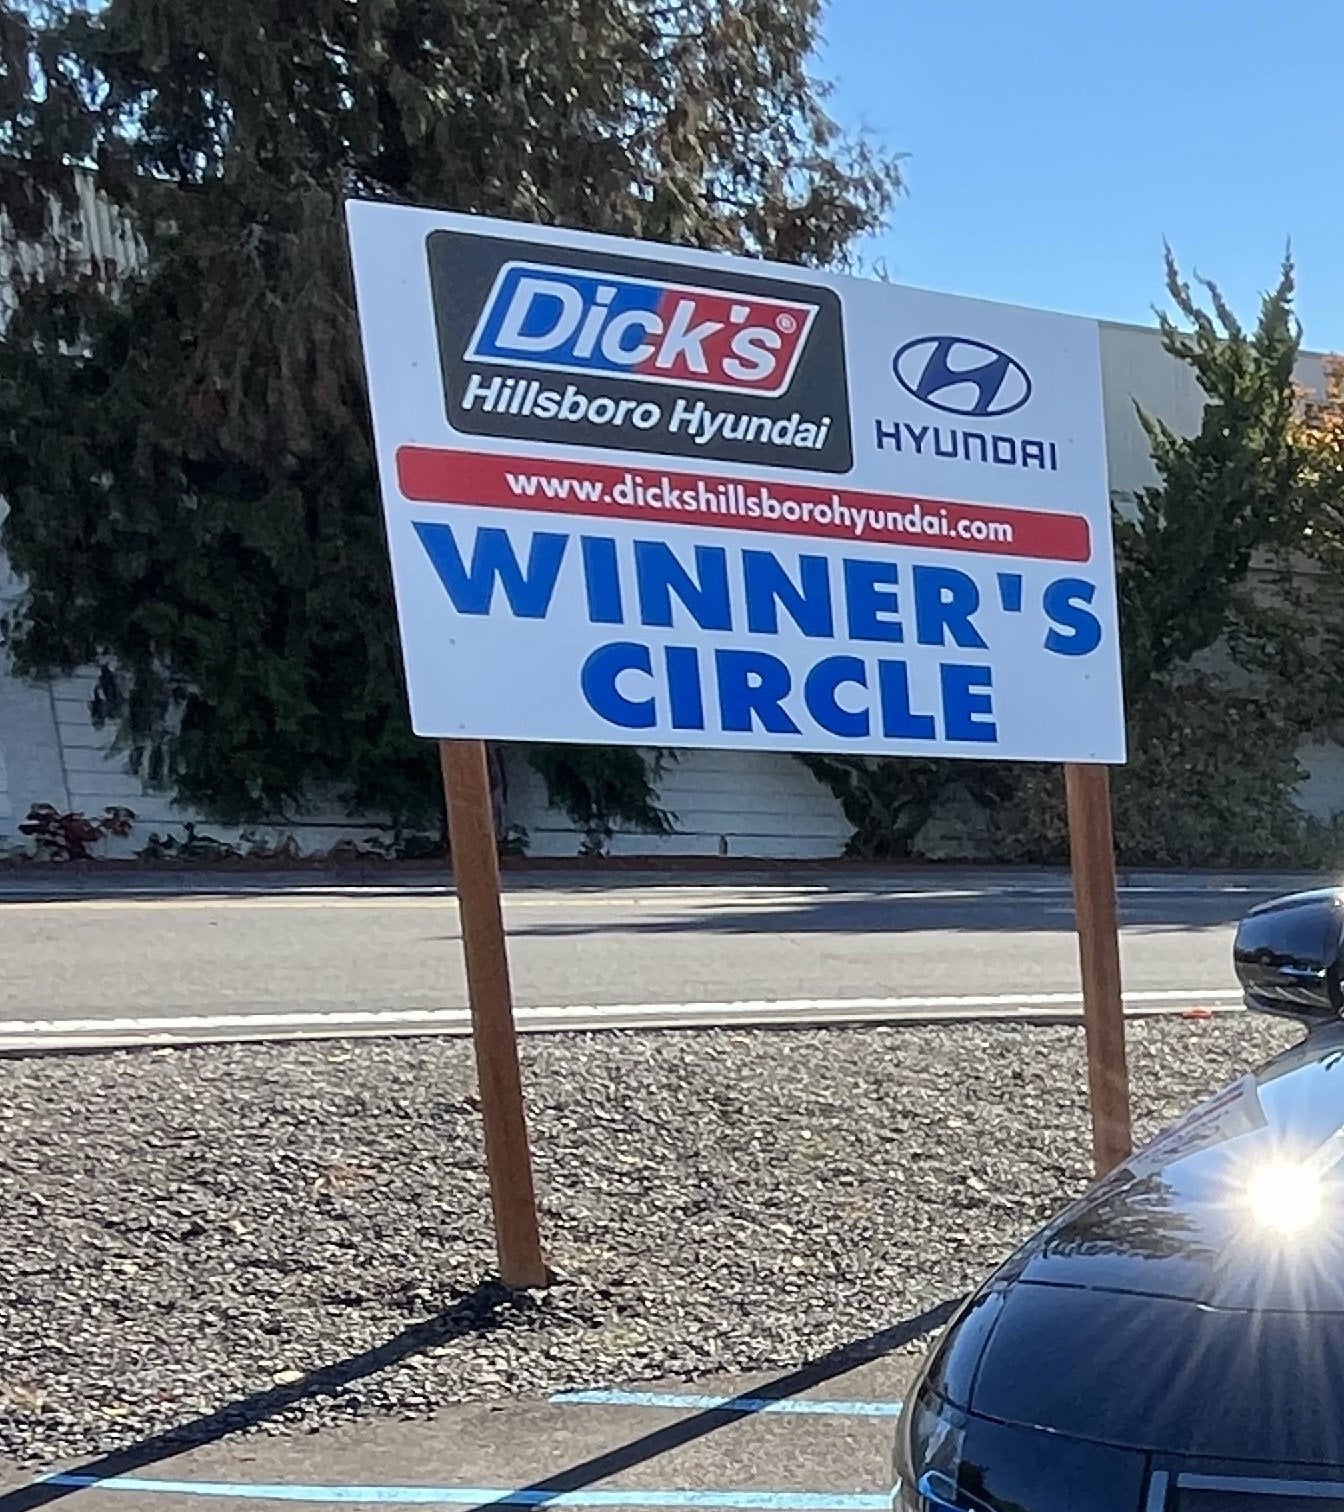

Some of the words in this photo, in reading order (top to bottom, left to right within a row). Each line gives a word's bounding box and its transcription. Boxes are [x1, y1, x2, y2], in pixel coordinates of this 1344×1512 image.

[461, 374, 661, 430] Hillsboro
[668, 398, 831, 450] Hyundai
[875, 420, 1058, 471] HYUNDAI
[505, 471, 1014, 543] www.dickshillsborohyundai.com
[412, 521, 1101, 656] WINNER'S
[580, 642, 998, 743] CIRCLE
